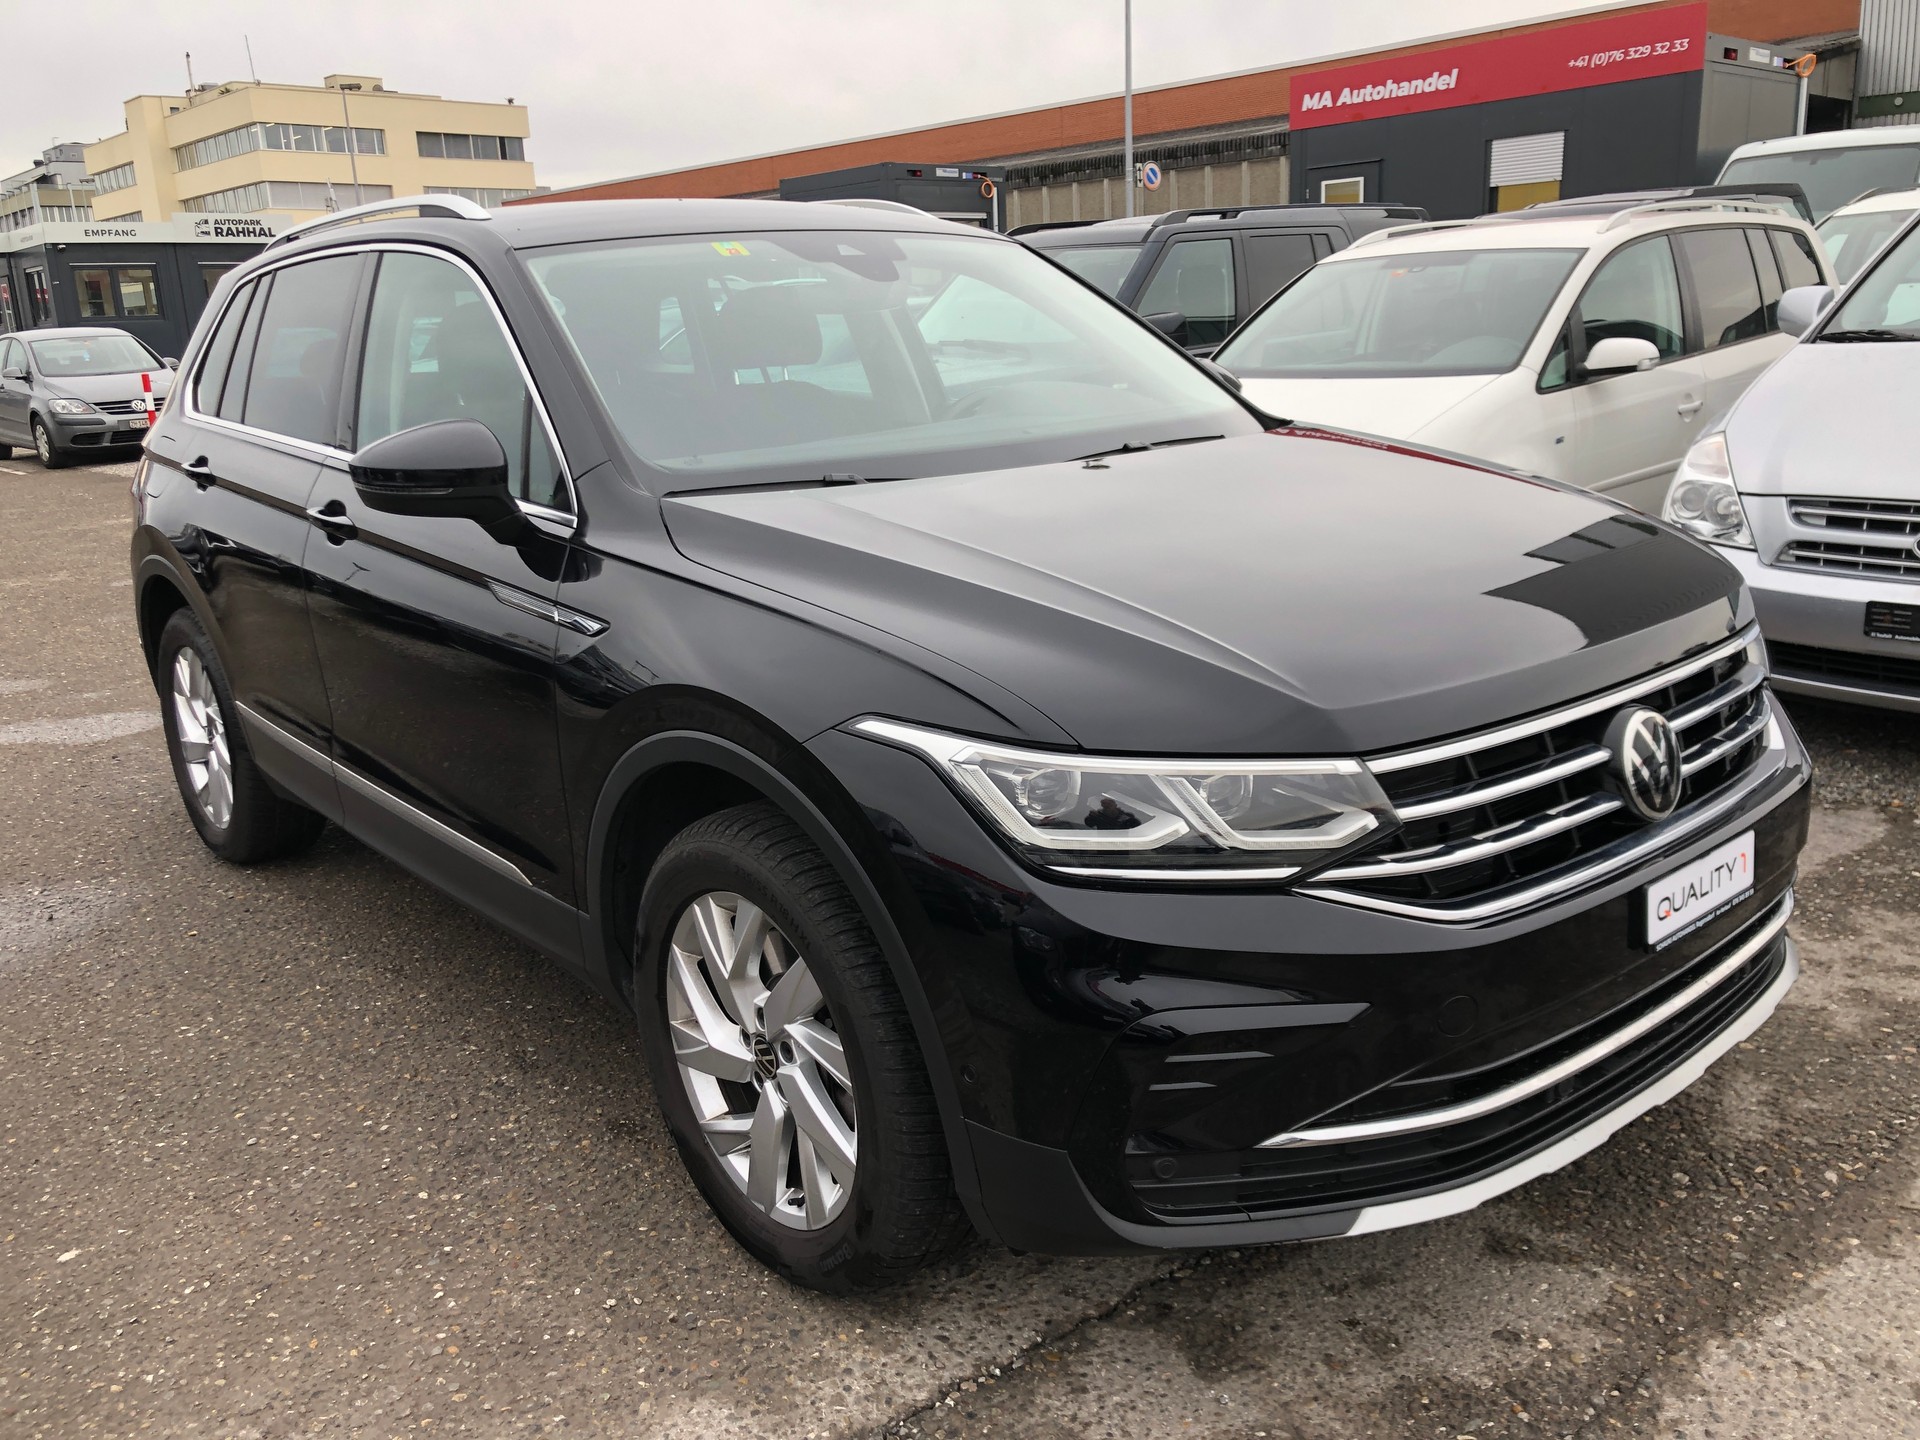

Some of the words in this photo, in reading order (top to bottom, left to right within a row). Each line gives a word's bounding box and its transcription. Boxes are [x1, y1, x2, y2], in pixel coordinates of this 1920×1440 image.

[1568, 55, 1589, 68] +41
[1591, 49, 1625, 68] (0)76
[1626, 45, 1651, 60] 329
[1653, 42, 1670, 55] 32
[1671, 38, 1690, 52] 33
[1301, 90, 1333, 111] MA
[1336, 68, 1459, 106] Autohandel
[84, 229, 137, 237] EMPFANG
[214, 226, 276, 238] RAHHAL
